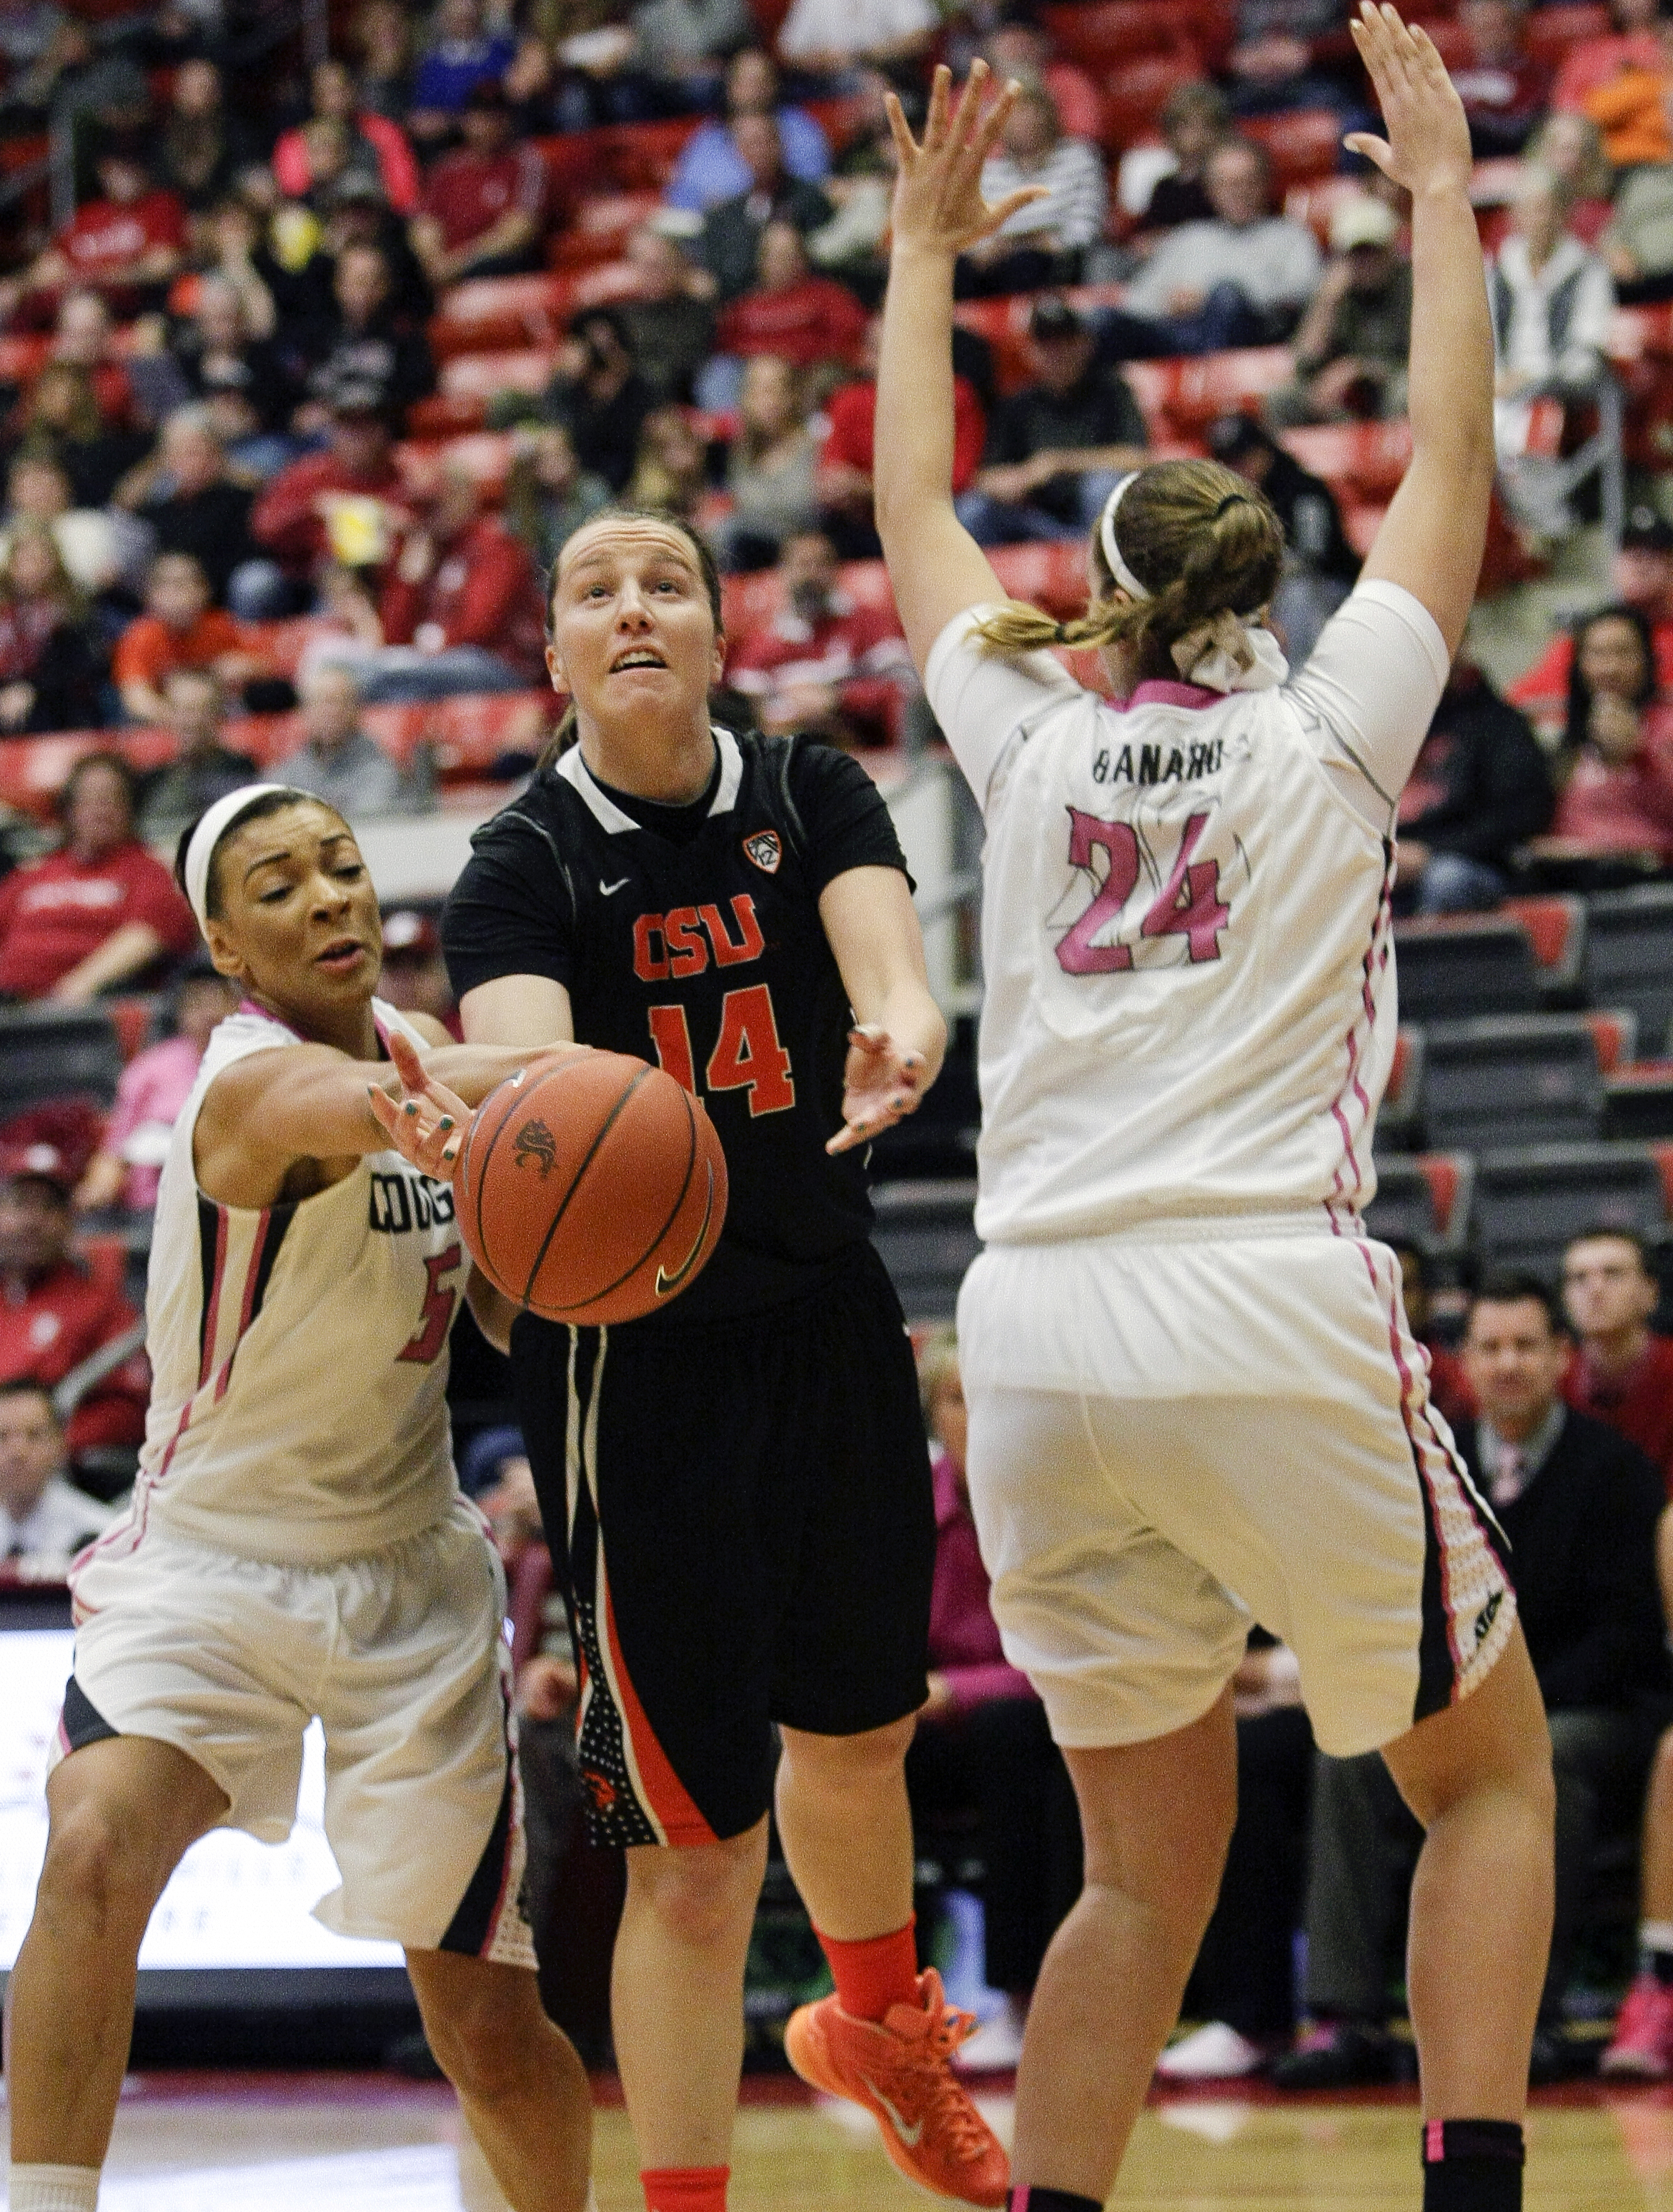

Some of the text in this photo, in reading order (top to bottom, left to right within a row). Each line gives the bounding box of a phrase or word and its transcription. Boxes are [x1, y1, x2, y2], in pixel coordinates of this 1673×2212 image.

[632, 893, 765, 983] OSU
[1054, 803, 1231, 975] 24
[647, 983, 795, 1119] 14
[394, 1241, 462, 1364] 5
